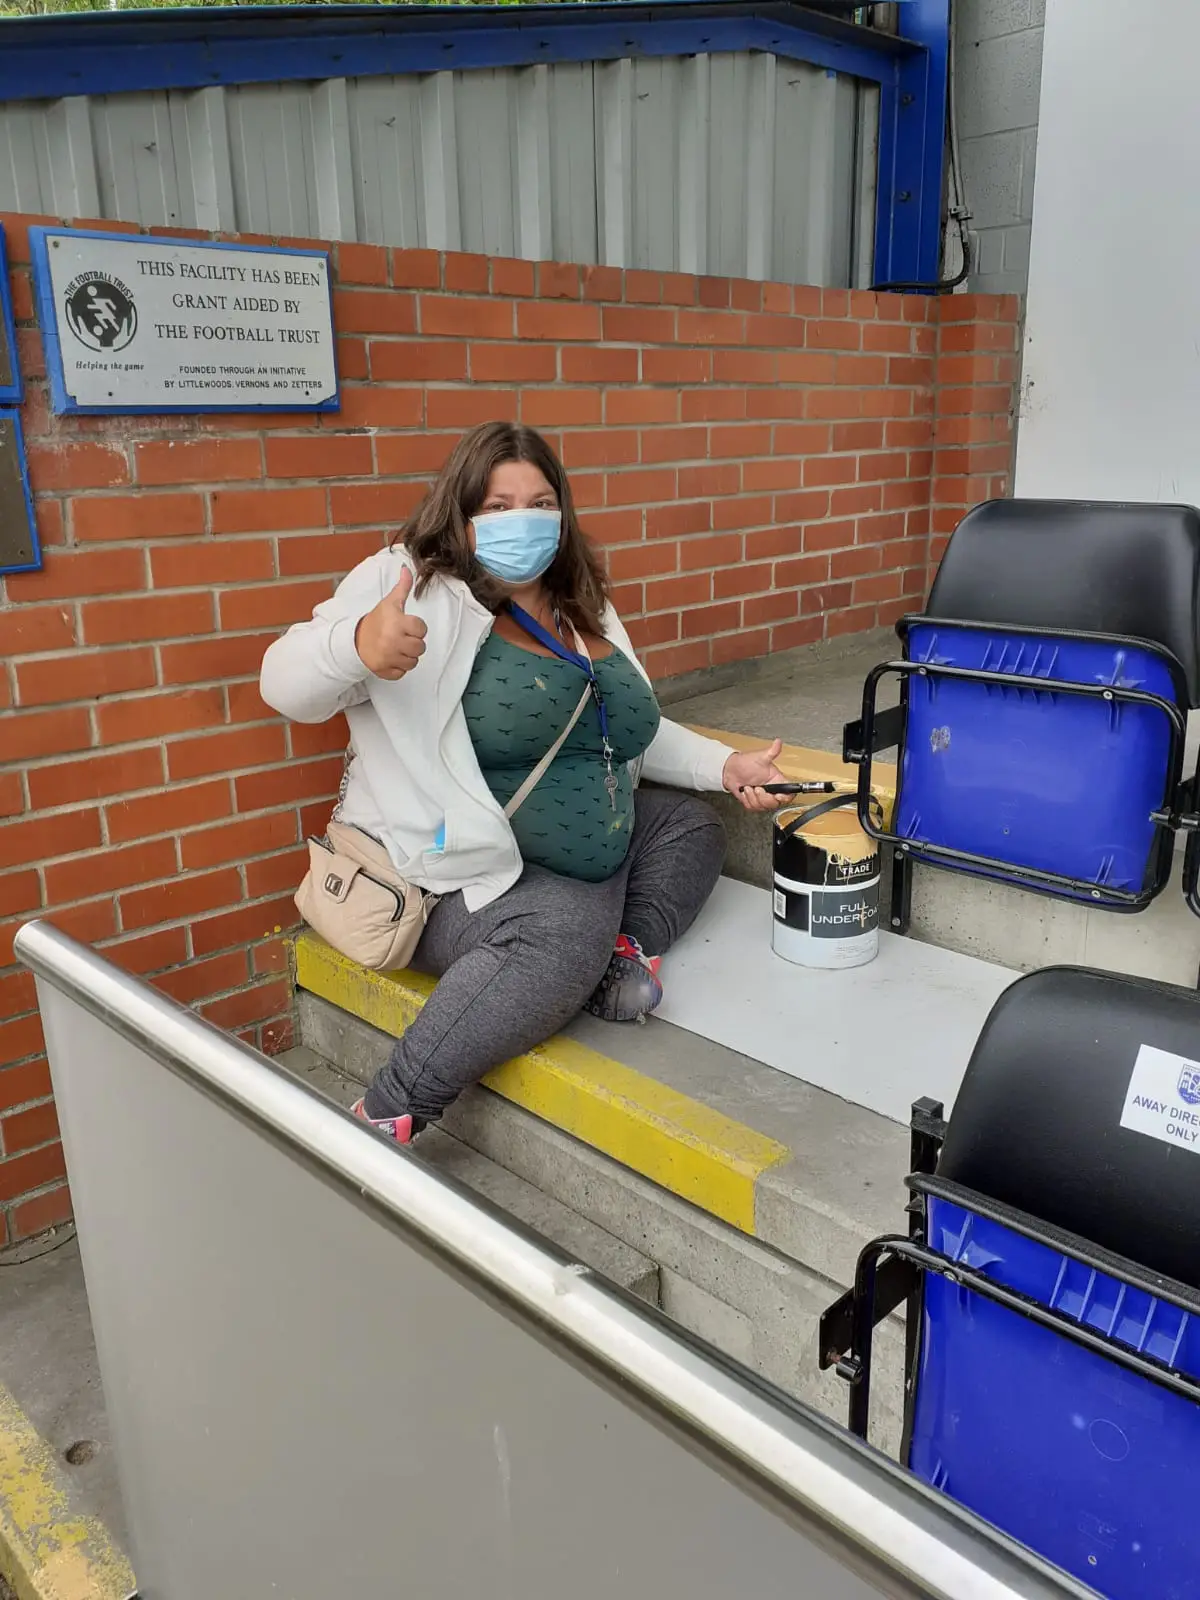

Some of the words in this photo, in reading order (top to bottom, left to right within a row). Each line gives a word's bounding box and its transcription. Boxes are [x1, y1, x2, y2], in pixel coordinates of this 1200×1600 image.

[137, 260, 175, 277] THIS
[180, 263, 247, 282] FACILITY
[251, 268, 281, 284] HAS
[284, 271, 321, 287] BEEN
[64, 280, 78, 297] THE
[74, 270, 113, 285] FOOTBALL
[112, 277, 134, 299] TRUST
[172, 293, 228, 310] GRANT
[233, 297, 279, 313] AIDED
[284, 300, 301, 314] BY
[155, 324, 188, 339] THE
[193, 325, 274, 342] FOOTBALL
[278, 329, 320, 344] TRUST
[75, 360, 108, 371] Helping
[110, 361, 122, 370] the
[124, 363, 145, 371] game
[179, 365, 217, 374] FOUNDED
[219, 366, 255, 375] THROUGH
[257, 366, 268, 375] AN
[270, 366, 307, 376] INITIATIVE
[164, 380, 174, 388] BY
[235, 380, 270, 389] VERNONS
[273, 380, 288, 389] AND
[291, 380, 323, 389] ZETTERS
[842, 863, 871, 876] TRADE
[812, 905, 879, 924] UNDERCOA
[839, 902, 869, 913] FULL
[1132, 1095, 1168, 1115] AWAY
[1169, 1106, 1200, 1127] DIRE
[1165, 1123, 1199, 1142] ONLY
